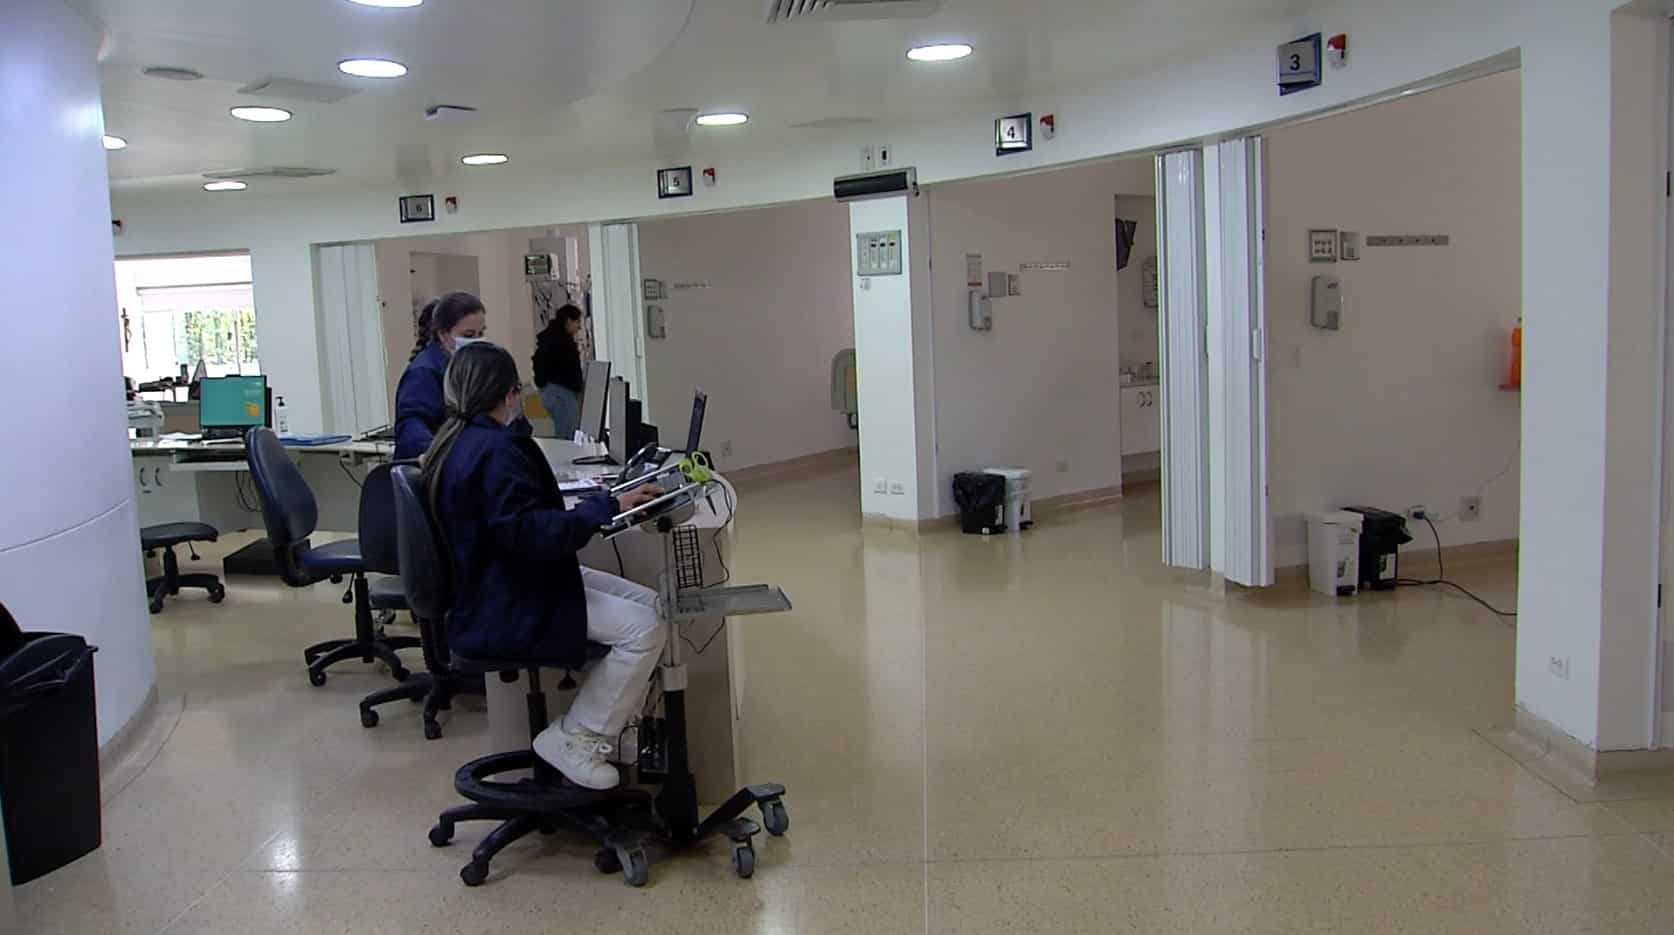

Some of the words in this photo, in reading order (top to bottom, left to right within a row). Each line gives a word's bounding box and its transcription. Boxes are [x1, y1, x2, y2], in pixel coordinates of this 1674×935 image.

[1290, 54, 1300, 71] 3
[1007, 125, 1015, 139] 4
[672, 176, 680, 187] 5
